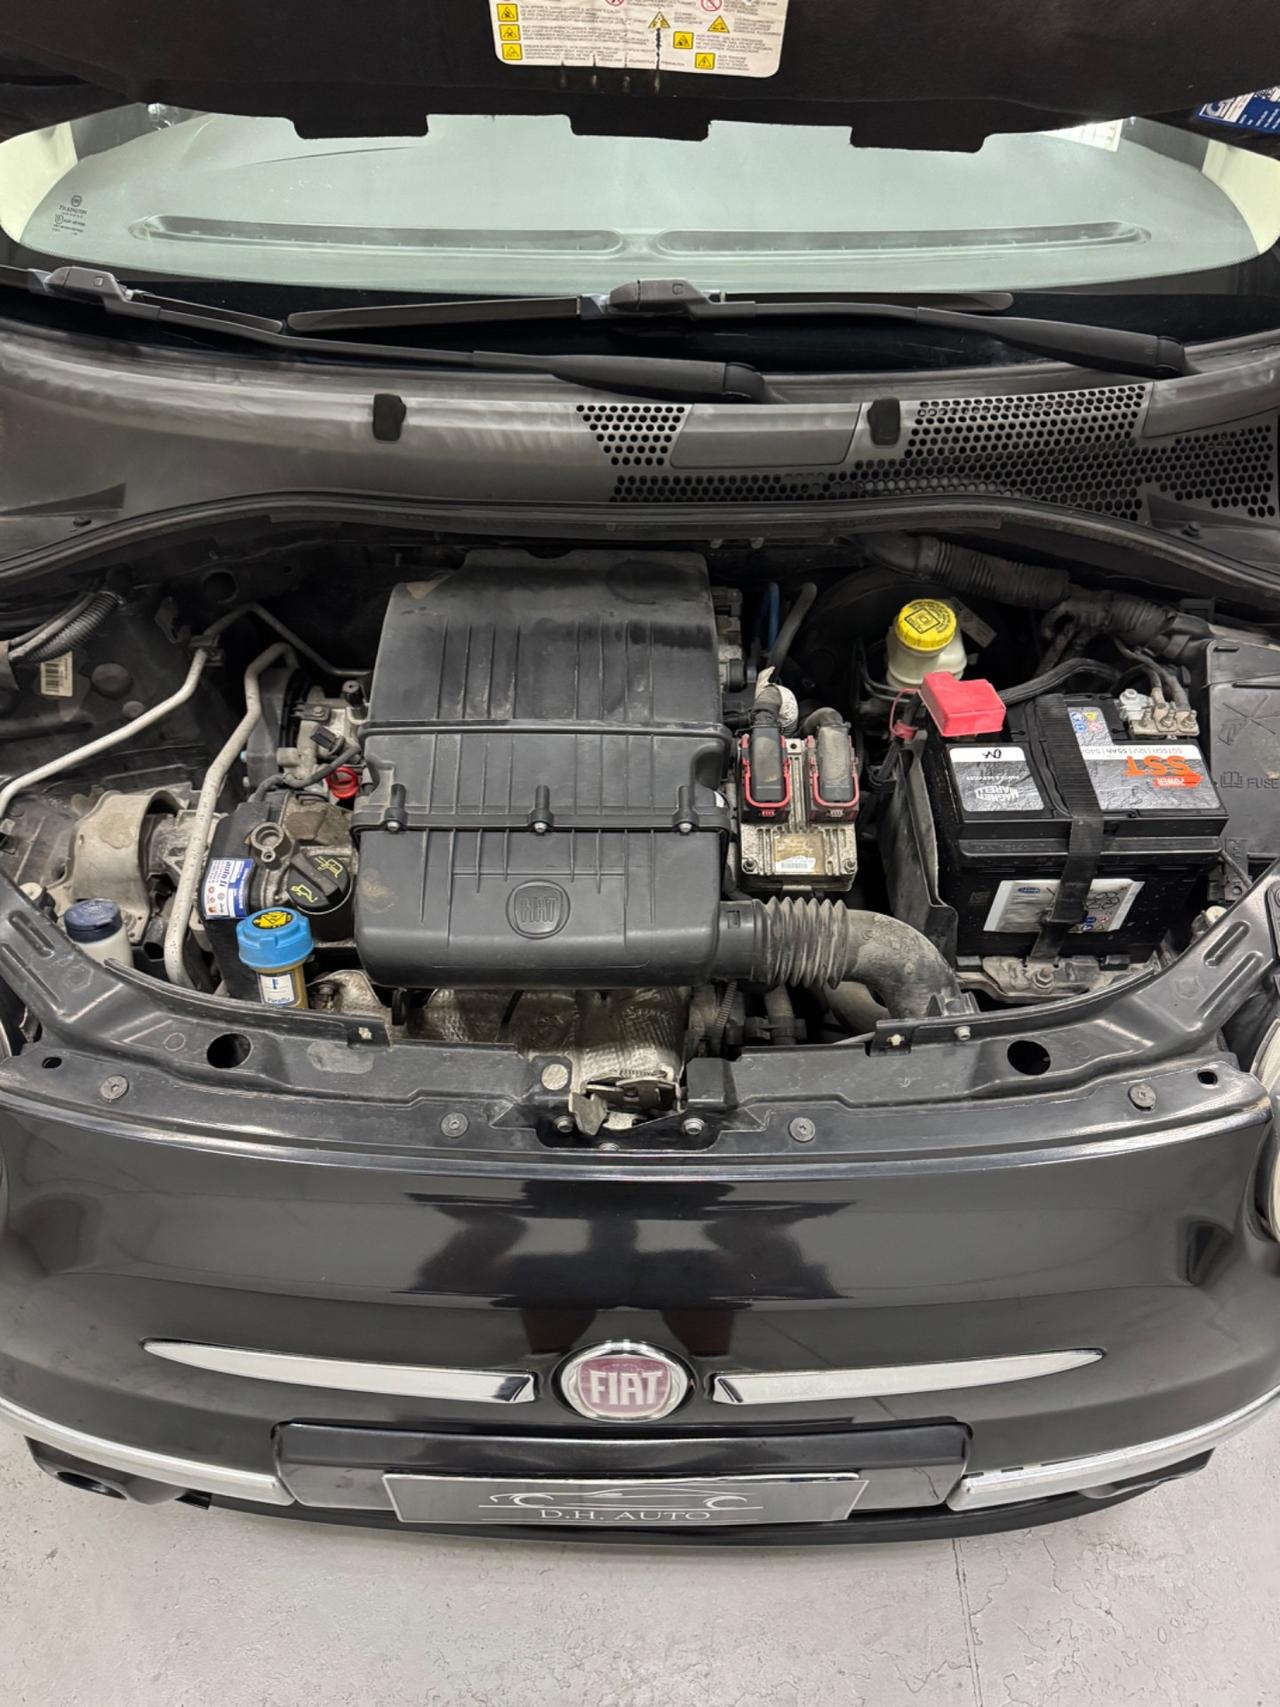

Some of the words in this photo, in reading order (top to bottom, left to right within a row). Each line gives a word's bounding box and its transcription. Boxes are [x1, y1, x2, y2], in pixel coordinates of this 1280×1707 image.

[1121, 755, 1192, 777] SST
[520, 897, 559, 923] FIAT
[590, 1370, 663, 1405] FIAT
[540, 1509, 604, 1520] D.H.
[614, 1511, 711, 1521] AUTO
